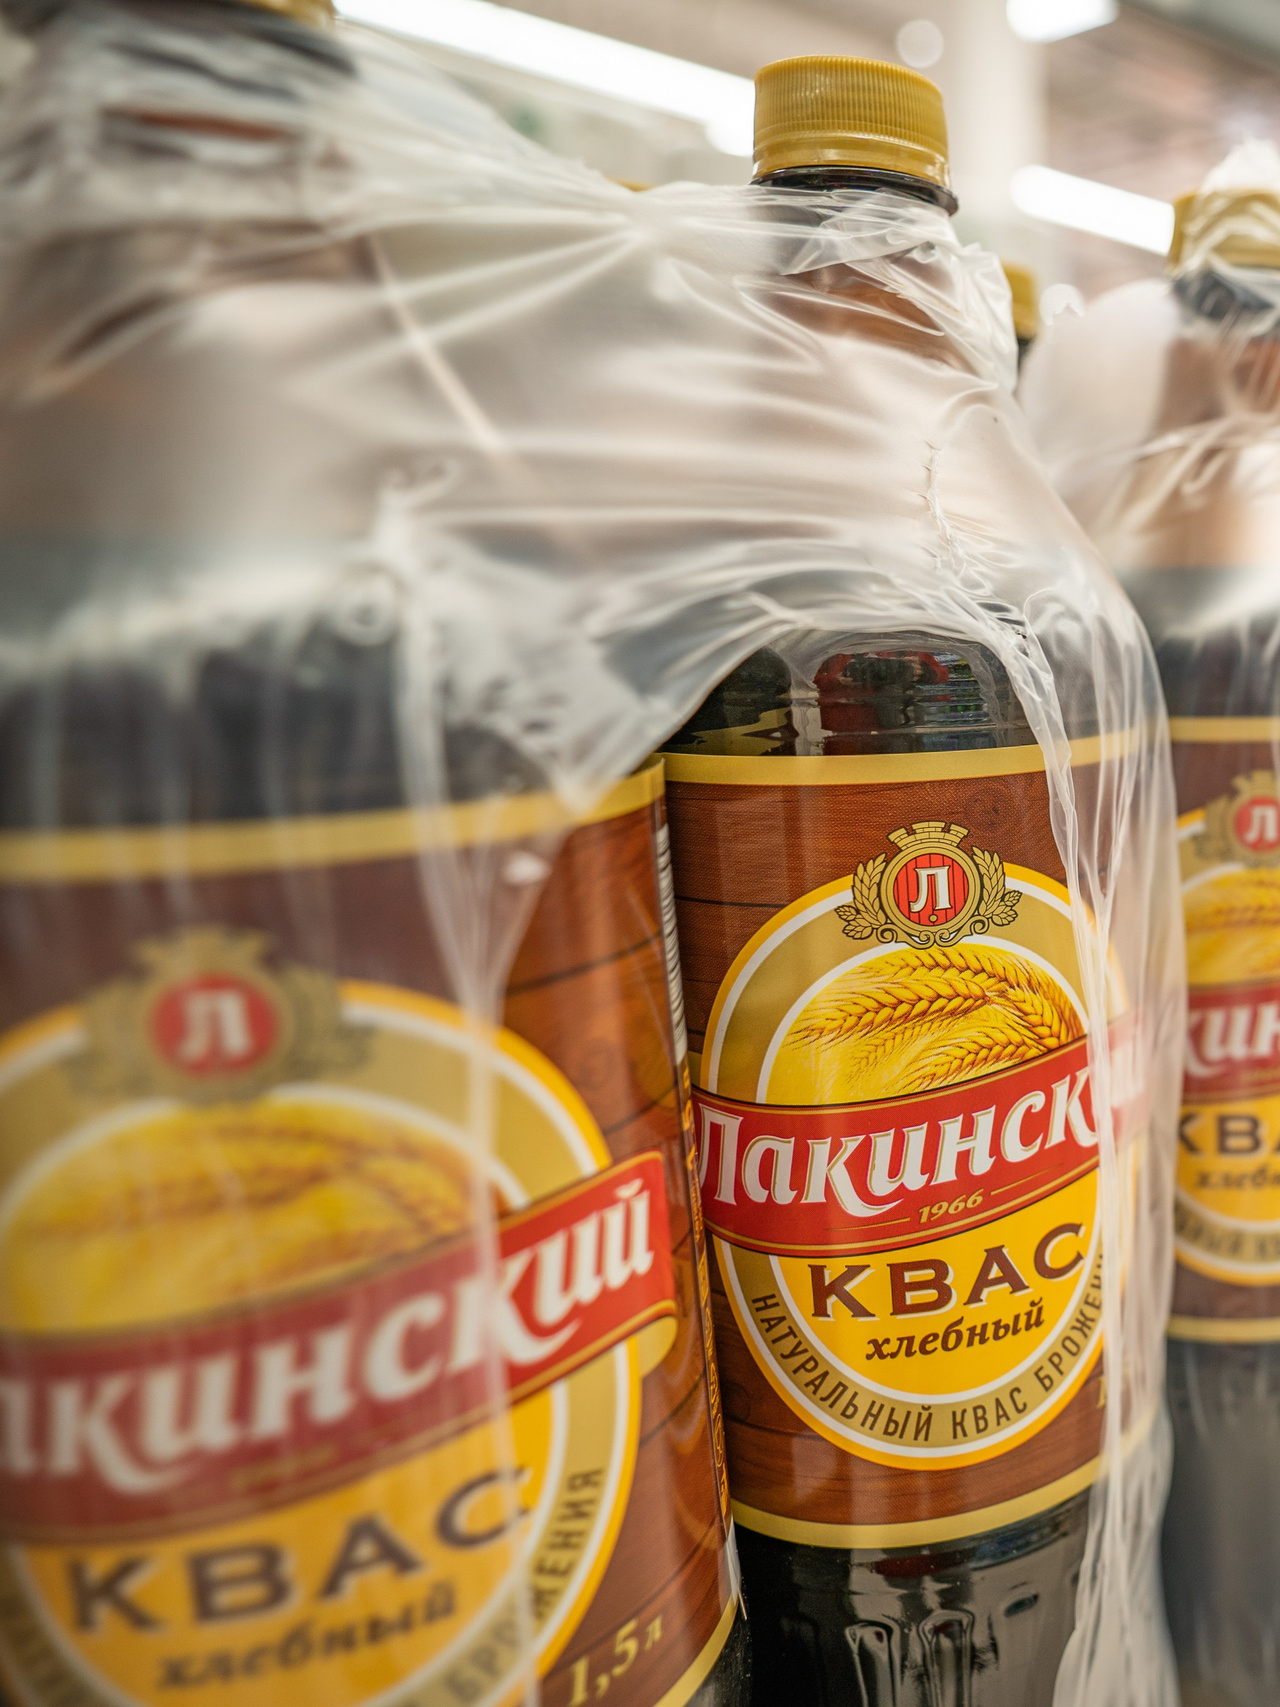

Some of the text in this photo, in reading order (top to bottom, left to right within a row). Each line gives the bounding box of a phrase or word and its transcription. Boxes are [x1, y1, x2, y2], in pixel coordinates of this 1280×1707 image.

[1245, 804, 1280, 843] Л
[910, 863, 952, 914] Л
[182, 990, 252, 1062] Л
[698, 1043, 1146, 1218] Лакинск
[917, 1187, 985, 1225] 1966
[808, 1220, 1086, 1322] КВАС
[751, 1293, 934, 1443] НАТУРАЛЬНЫЙ
[951, 1386, 1030, 1441] КВАС
[865, 1297, 1046, 1362] хлебный
[65, 1465, 534, 1636] КВАС
[570, 1617, 640, 1707] 1,5
